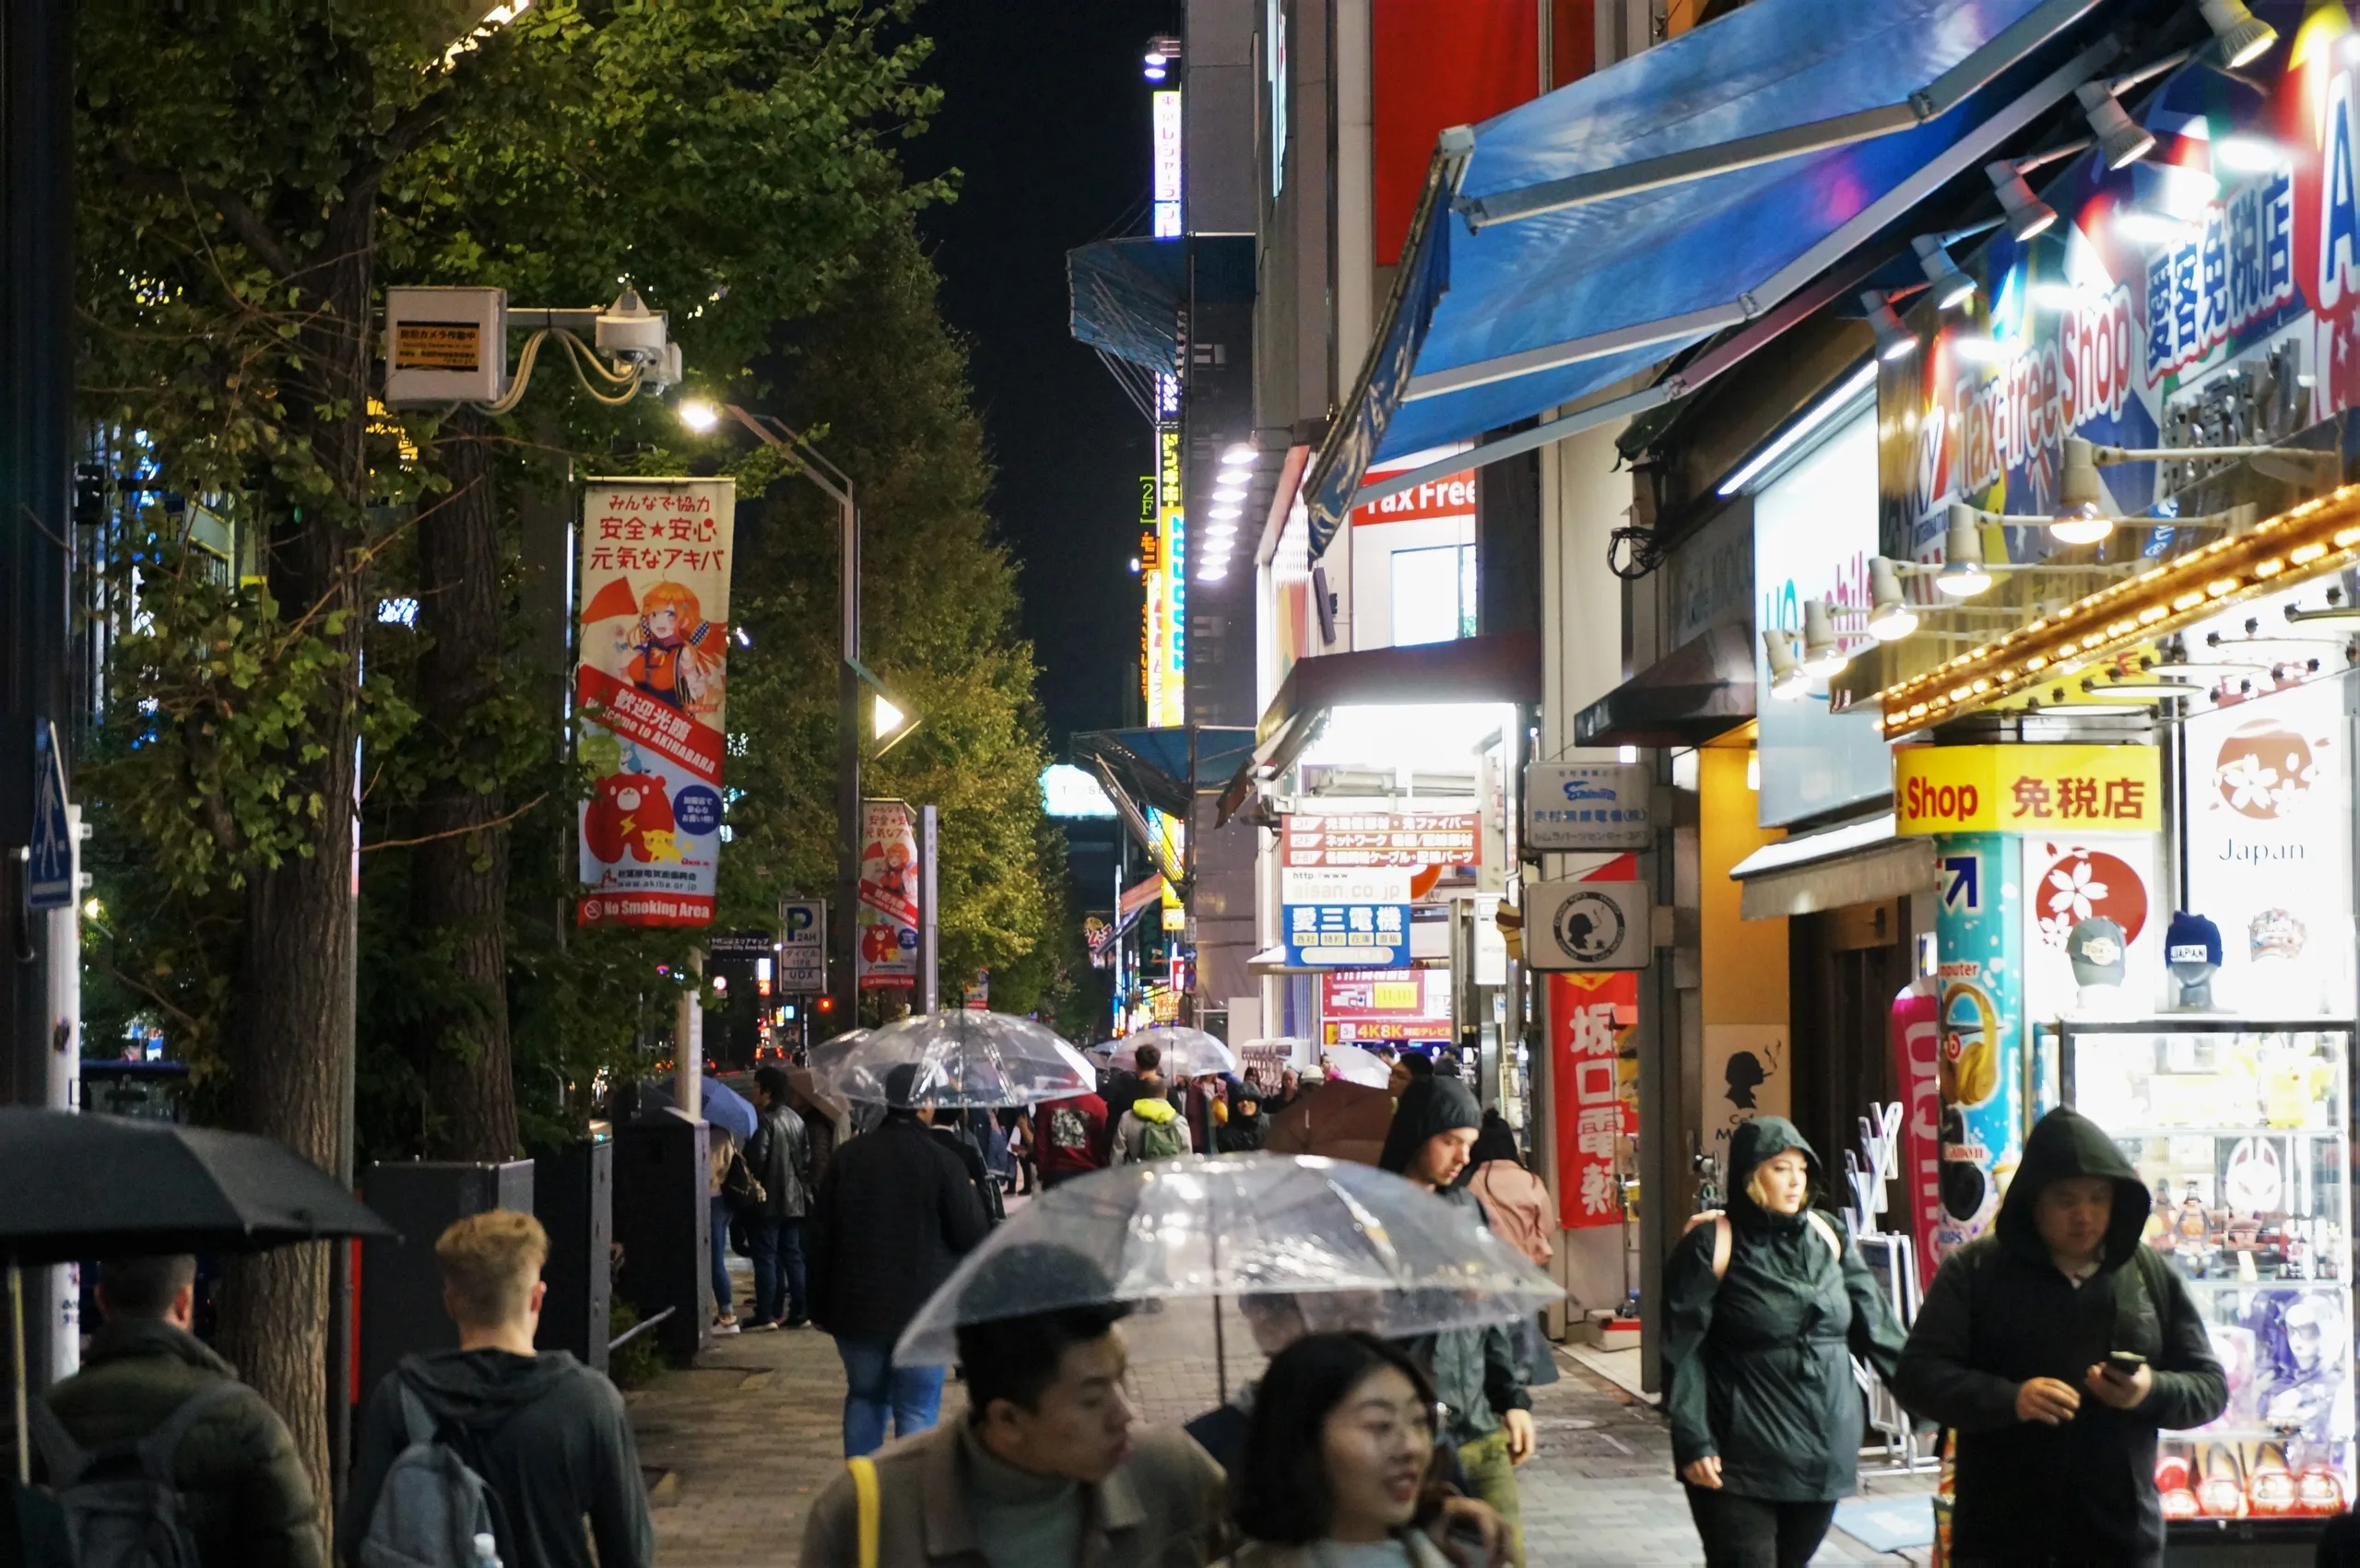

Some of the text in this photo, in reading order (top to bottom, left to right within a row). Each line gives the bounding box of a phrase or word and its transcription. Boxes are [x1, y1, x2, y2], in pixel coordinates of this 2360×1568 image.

[608, 494, 711, 513] みんなで協力
[590, 547, 725, 571] 元気なアキバ
[651, 731, 716, 774] AKIHABARA
[1907, 775, 1978, 821] Shop
[2010, 775, 2145, 819] 免税店
[1326, 834, 1387, 847] ネットワーク
[2218, 838, 2305, 866] Japan
[604, 900, 710, 918] No Smoking Area
[1292, 906, 1402, 932] 愛三電機
[787, 907, 813, 942] P
[796, 932, 817, 942] 24H
[2170, 949, 2206, 960] JAPAN
